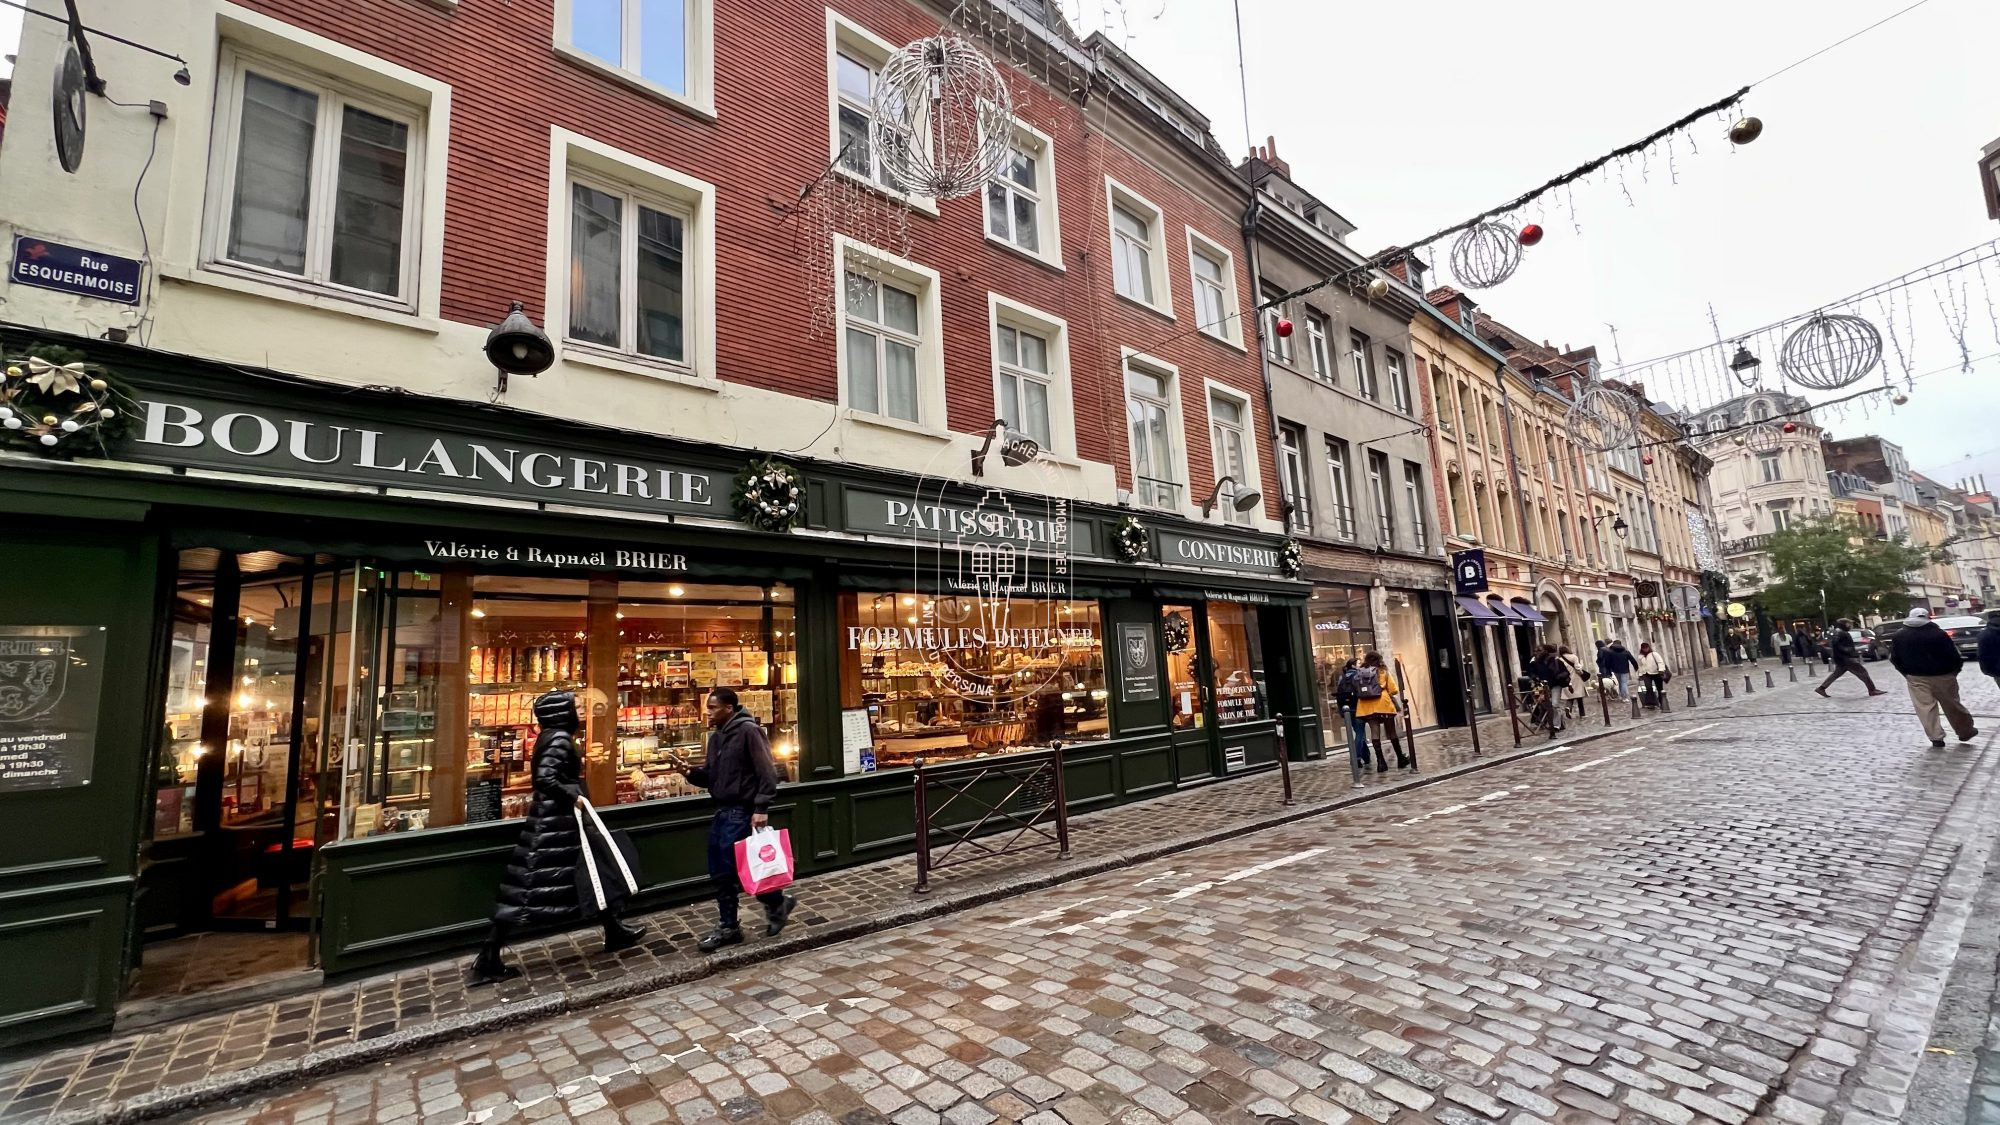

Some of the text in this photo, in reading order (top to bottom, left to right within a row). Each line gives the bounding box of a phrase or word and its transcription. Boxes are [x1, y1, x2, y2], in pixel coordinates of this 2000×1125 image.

[80, 256, 109, 272] Rue
[18, 262, 134, 295] ESQUERMOISE
[135, 400, 712, 505] BOULANGERIE
[884, 500, 1064, 544] PATISSERIE
[506, 546, 519, 561] &
[615, 550, 688, 571] BRIER
[1178, 539, 1280, 568] CONFISERIE
[1465, 565, 1476, 579] B
[1031, 581, 1066, 594] BRIER
[847, 626, 985, 650] FORMULES
[1218, 711, 1236, 720] SALON
[1236, 710, 1244, 718] DE
[17, 732, 67, 742] vendredi
[11, 742, 46, 752] 19h30
[9, 760, 44, 769] 19h30
[2, 768, 59, 779] dimanche
